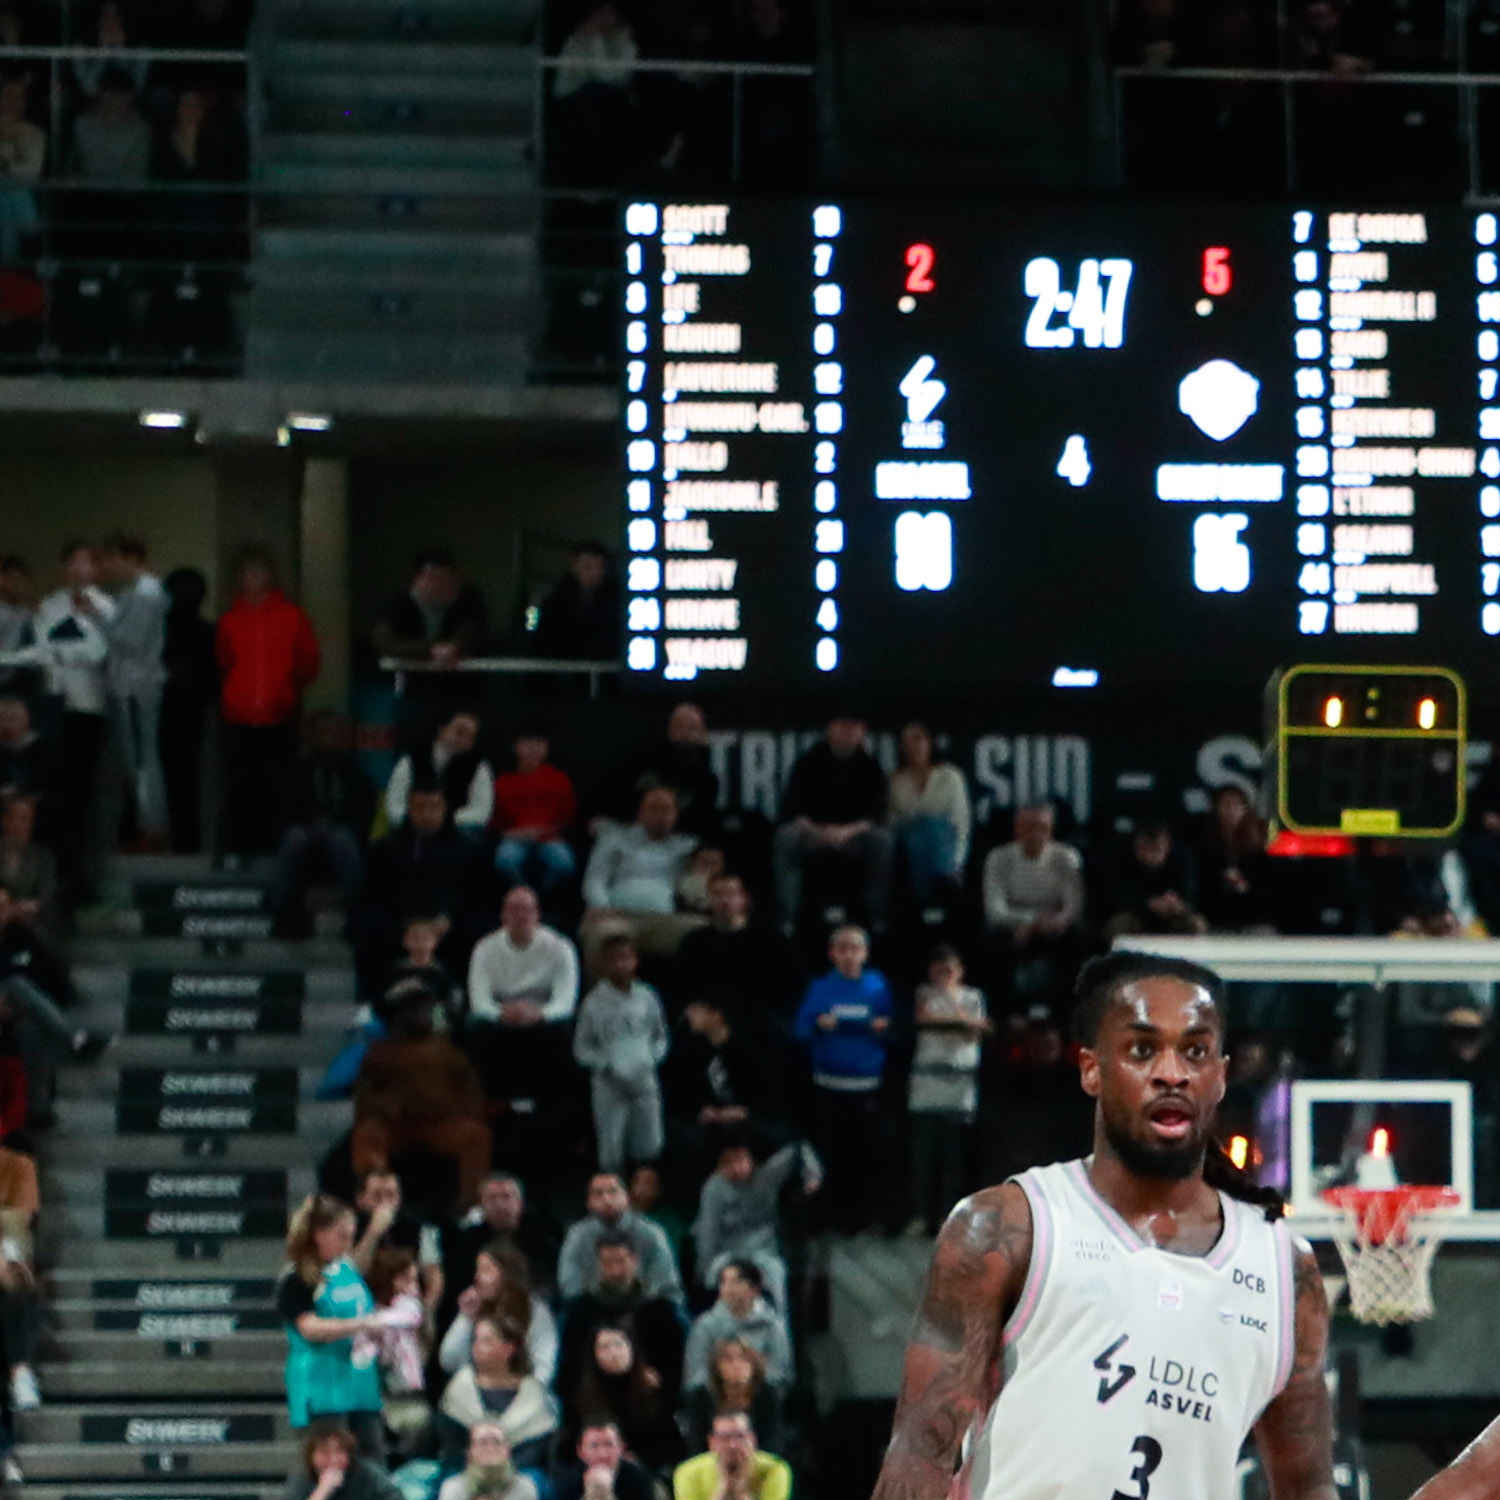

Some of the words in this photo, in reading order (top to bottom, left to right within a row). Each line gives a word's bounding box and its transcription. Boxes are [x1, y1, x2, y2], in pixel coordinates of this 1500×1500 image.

[626, 241, 643, 275] 1
[813, 243, 834, 276] 7
[904, 243, 935, 293] 2
[1203, 246, 1231, 295] 5
[1023, 256, 1133, 349] 2:47
[627, 360, 647, 392] 7
[1479, 368, 1499, 401] 7
[815, 440, 836, 473] 2
[1056, 433, 1092, 487] 4
[817, 598, 838, 632] 4
[975, 735, 1090, 825] SUD
[1232, 1268, 1267, 1294] DCB
[1148, 1355, 1220, 1398] LDLC
[1145, 1388, 1214, 1423] ASVEL
